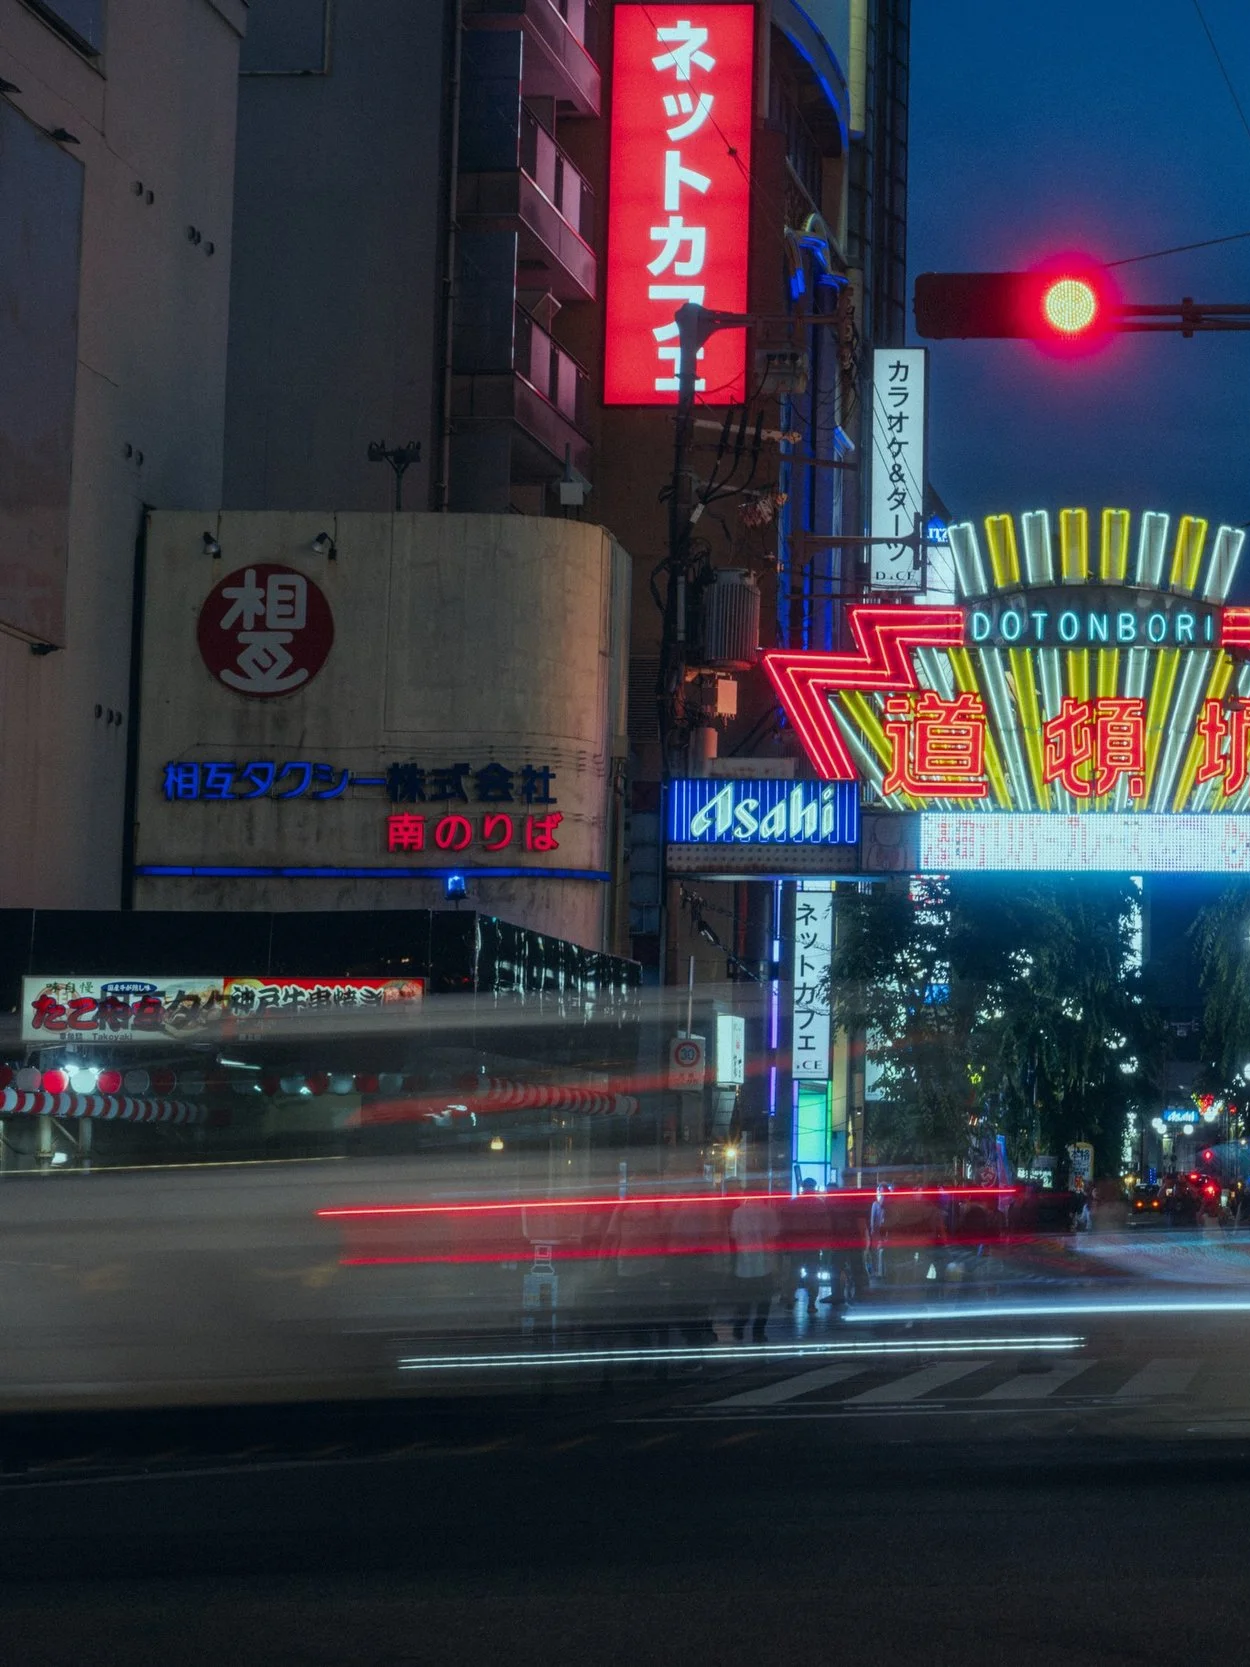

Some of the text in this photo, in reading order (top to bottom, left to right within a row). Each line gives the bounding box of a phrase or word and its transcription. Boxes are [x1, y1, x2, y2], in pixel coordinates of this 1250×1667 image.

[647, 20, 716, 392] ネットカフェ
[972, 611, 1213, 642] DOTONBORI
[386, 812, 564, 853] 南のりば
[690, 781, 835, 841] Asahi
[795, 904, 818, 1050] ネットカフェ
[93, 1033, 133, 1042] Takoyaki
